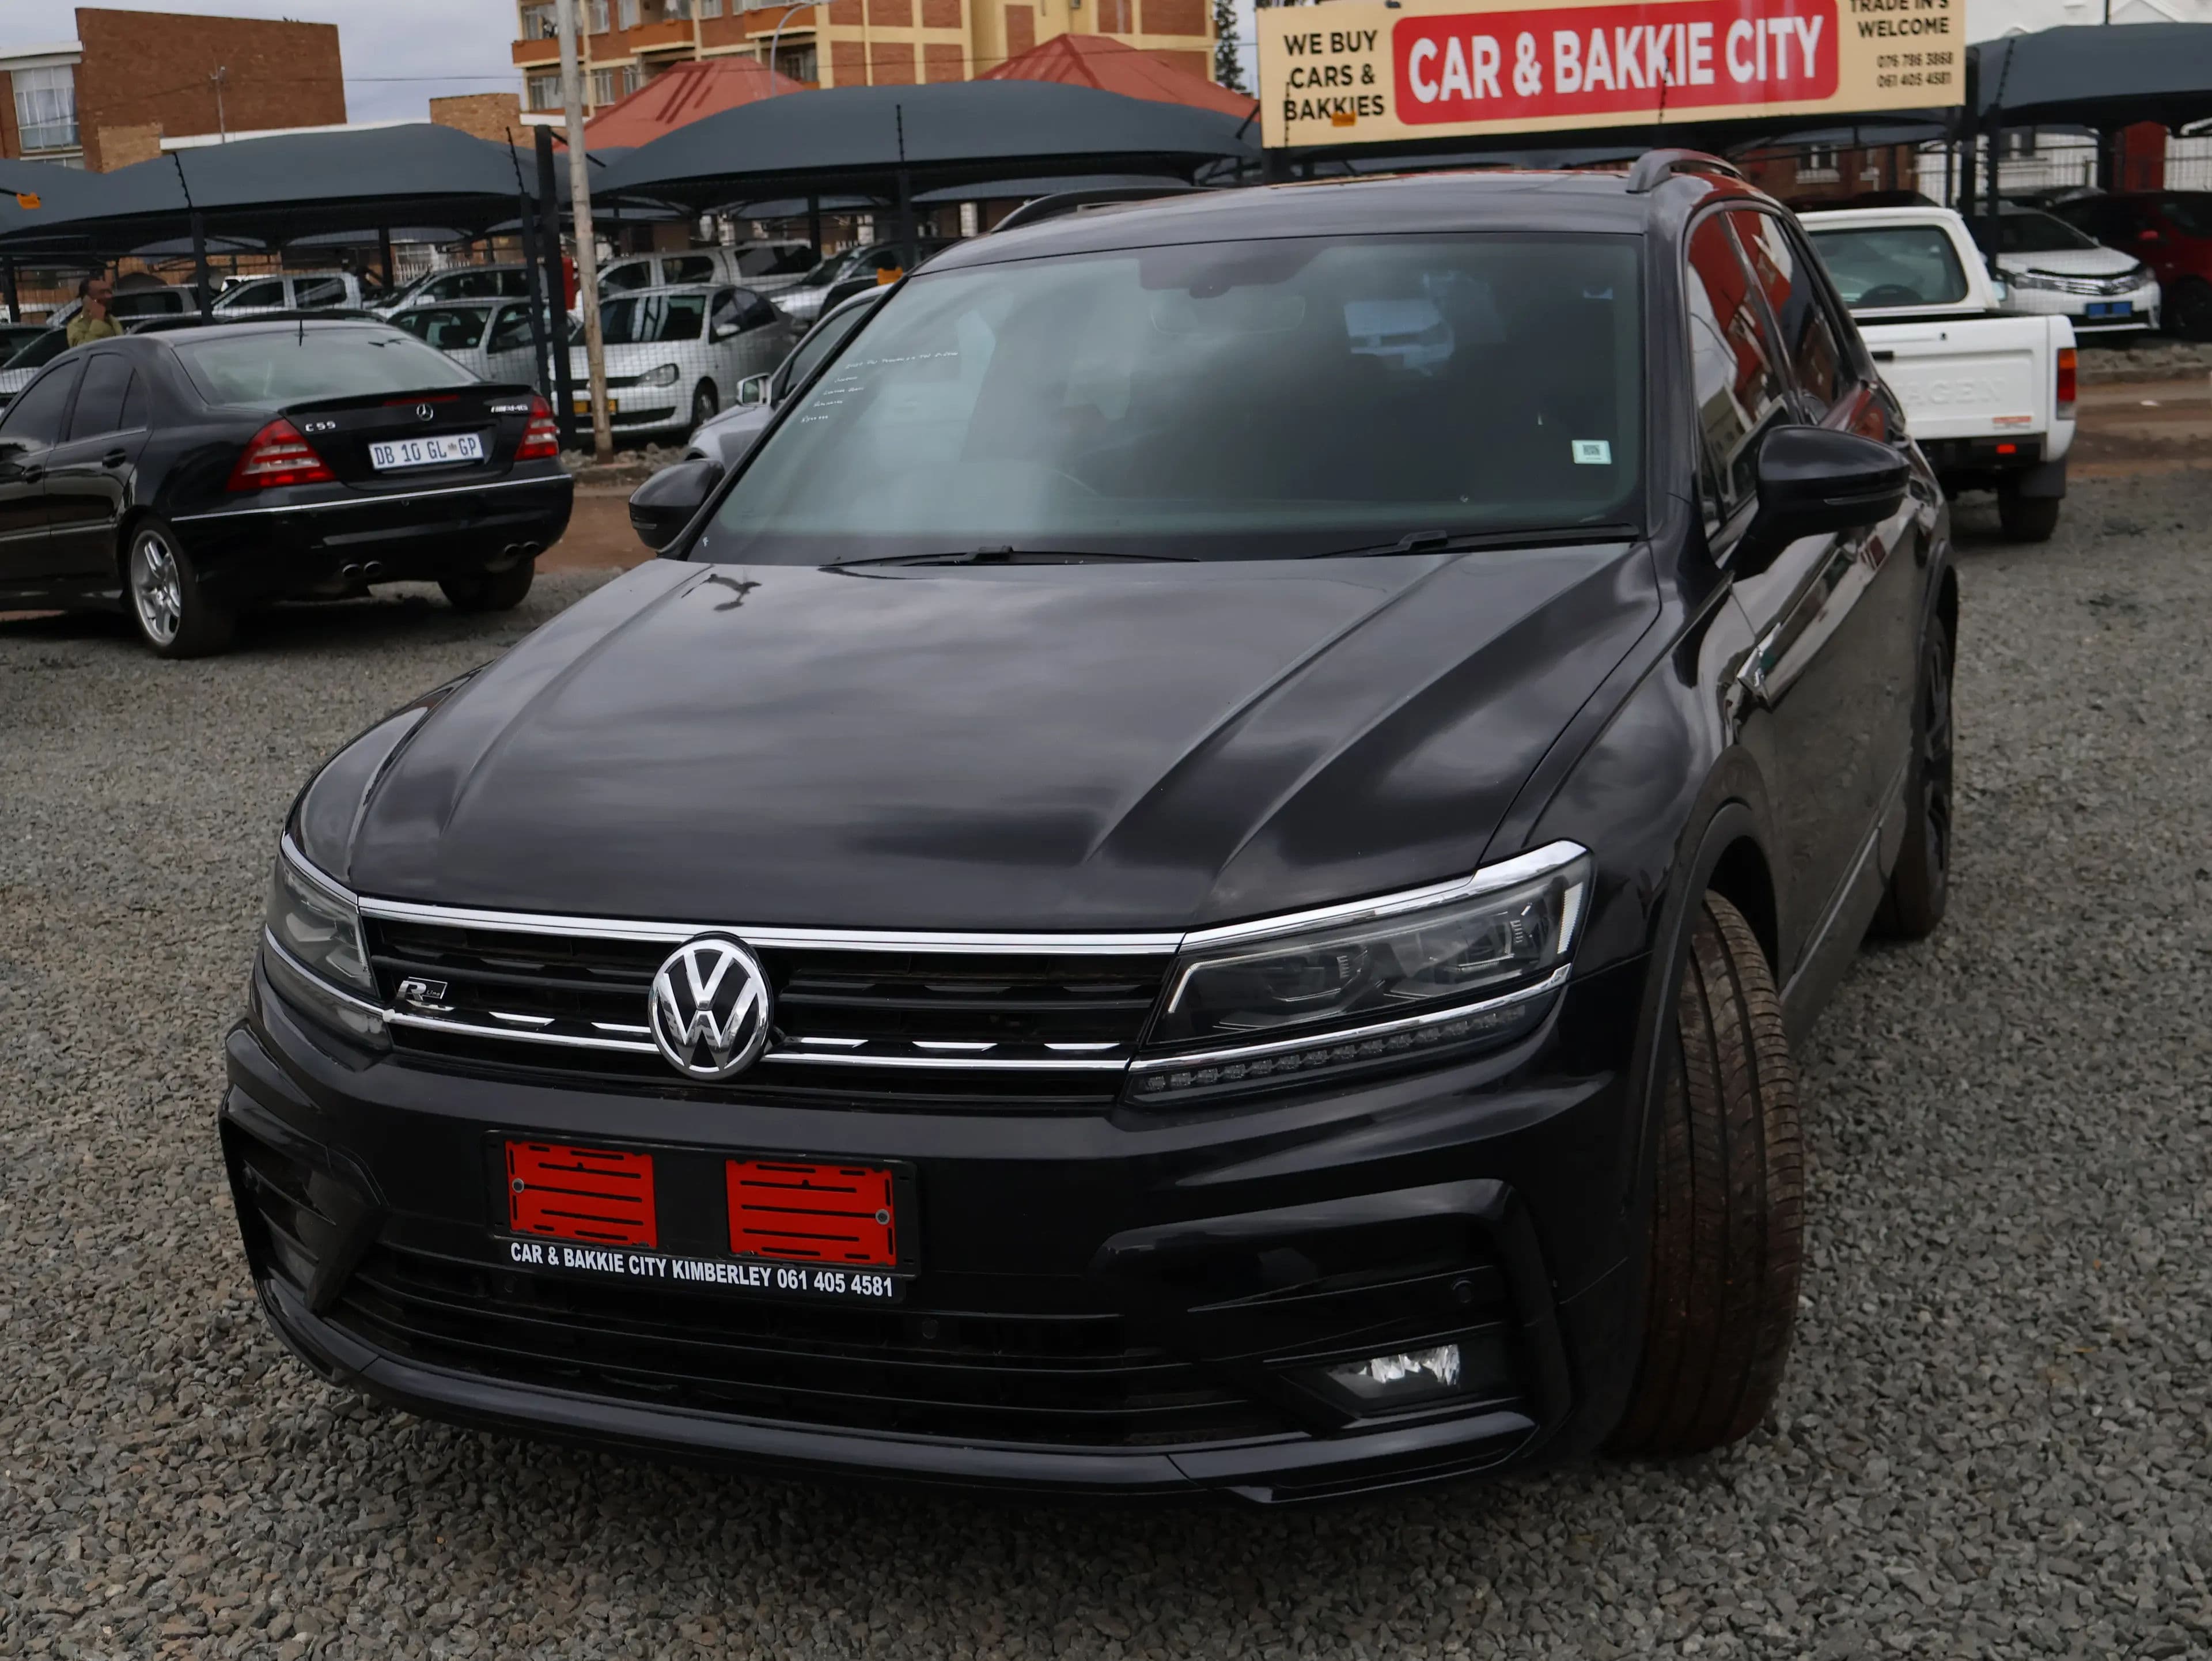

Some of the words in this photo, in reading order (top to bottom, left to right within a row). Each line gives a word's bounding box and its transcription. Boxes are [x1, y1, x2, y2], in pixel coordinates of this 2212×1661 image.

[1858, 17, 1950, 37] WELCOME
[1284, 33, 1323, 56] WE
[1330, 29, 1378, 53] BUY
[1408, 35, 1502, 103] CAR
[1513, 32, 1541, 96] &
[1553, 21, 1715, 93] BAKKIE
[1727, 15, 1824, 83] CITY
[1290, 65, 1353, 89] CARS
[1361, 63, 1376, 85] &
[1284, 94, 1385, 122] BAKKIES
[374, 446, 395, 466] DB
[402, 443, 421, 462] 10
[427, 440, 447, 459] GL
[458, 437, 476, 456] GP
[650, 939, 768, 1080] VW
[511, 1242, 543, 1263] CAR
[548, 1246, 559, 1266] &
[563, 1248, 624, 1273] BAKKIE
[628, 1255, 667, 1277] CITY
[672, 1260, 771, 1287] KIMBERLEY
[777, 1269, 807, 1290] 061
[814, 1272, 846, 1293] 405
[851, 1275, 892, 1297] 4581
